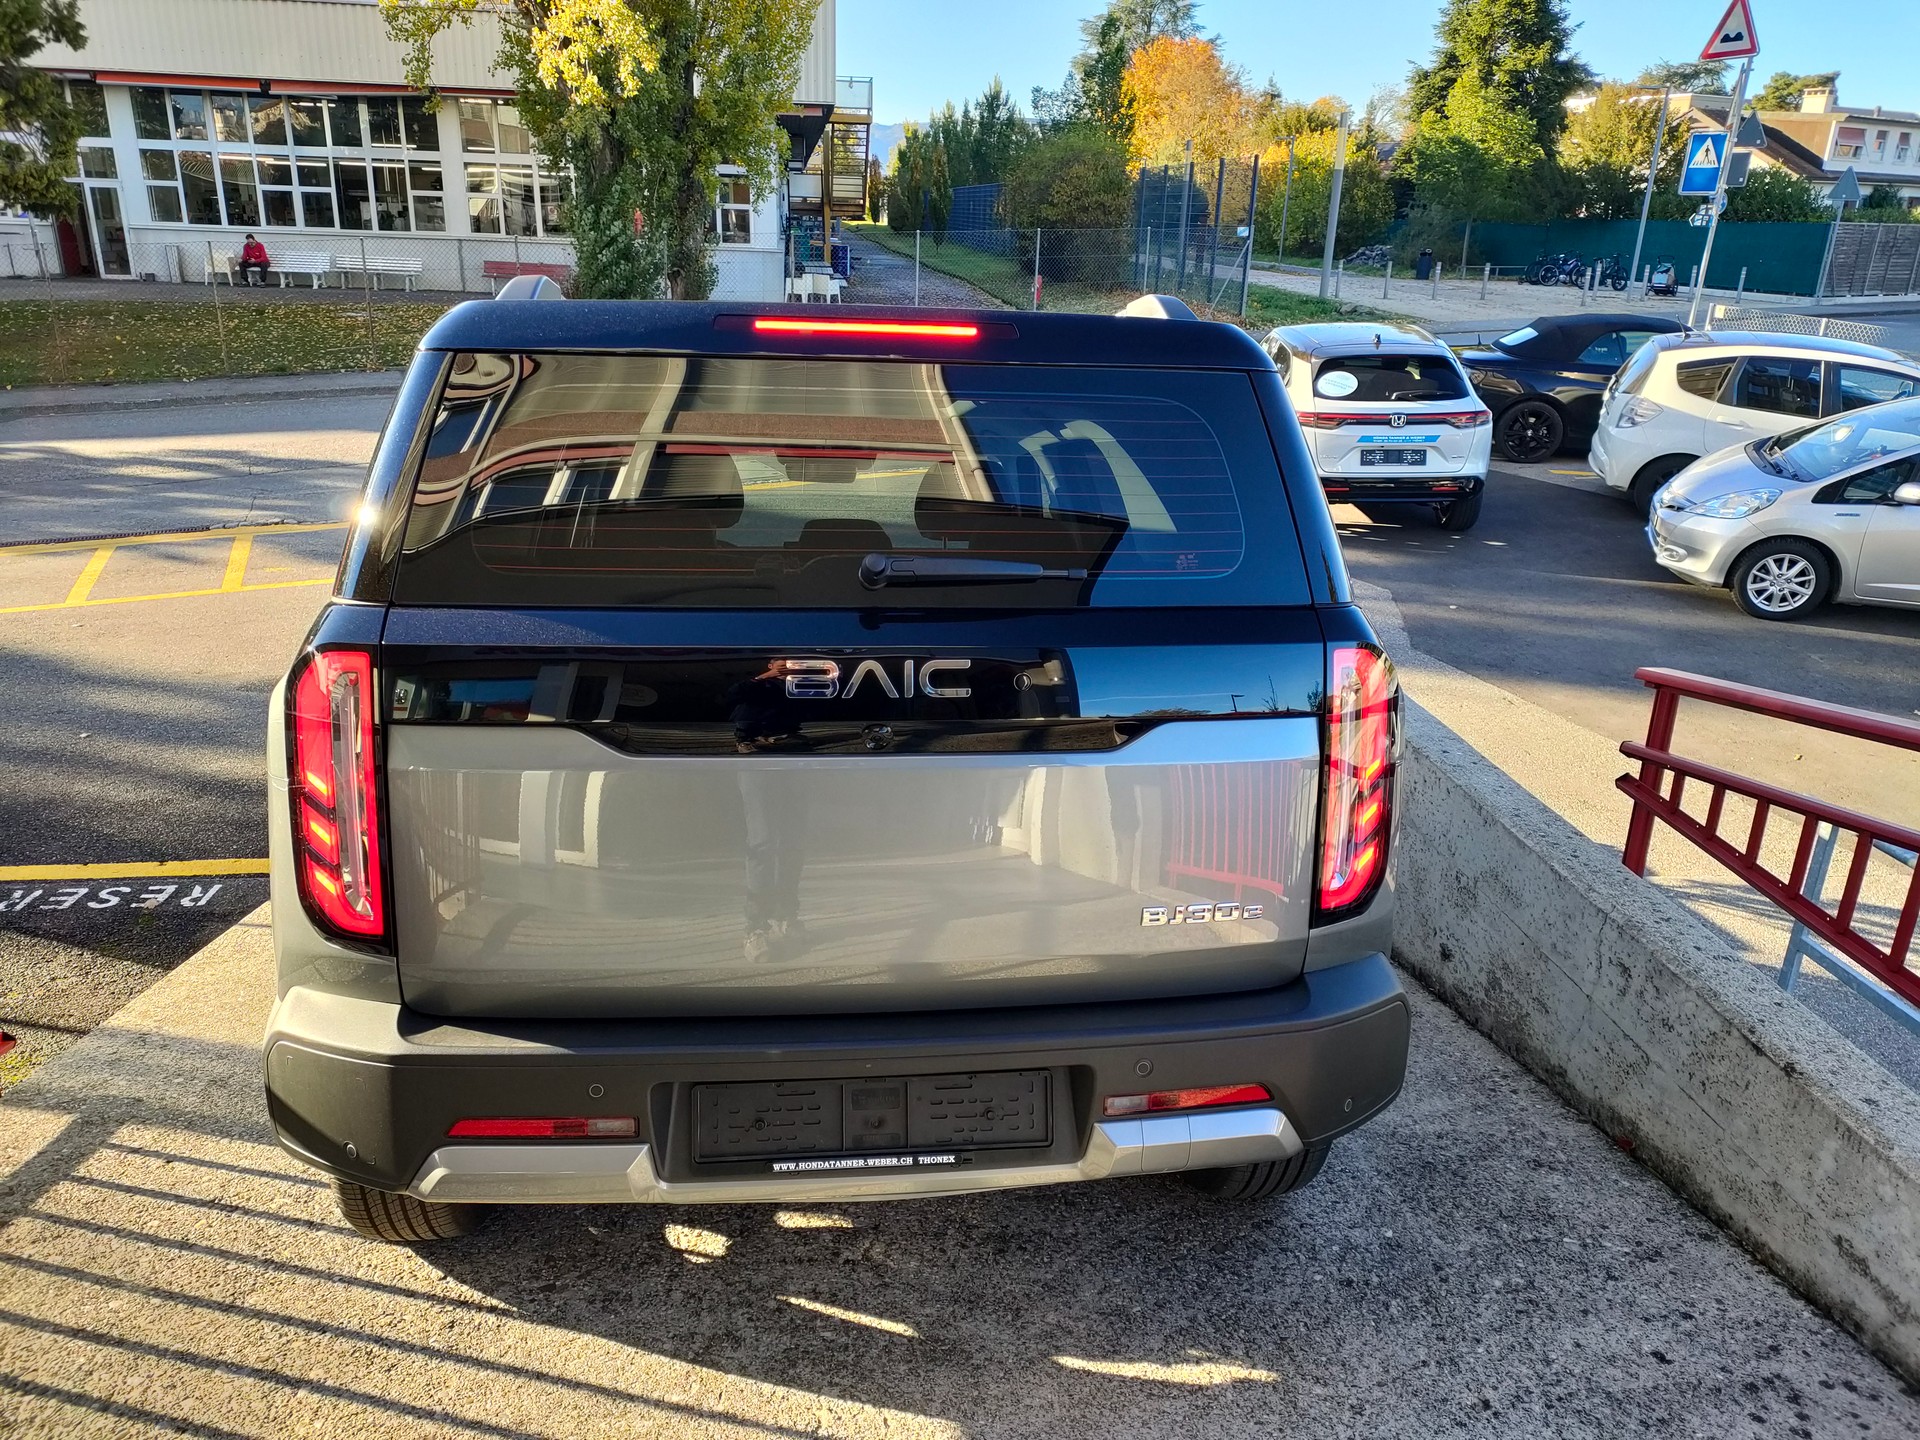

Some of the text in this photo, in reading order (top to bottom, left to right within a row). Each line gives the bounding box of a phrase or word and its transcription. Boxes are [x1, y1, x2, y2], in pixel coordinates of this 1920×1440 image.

[786, 659, 971, 699] BAIC
[773, 1155, 955, 1171] WWW.HONDATANNER-WEBER.CH THONEX
